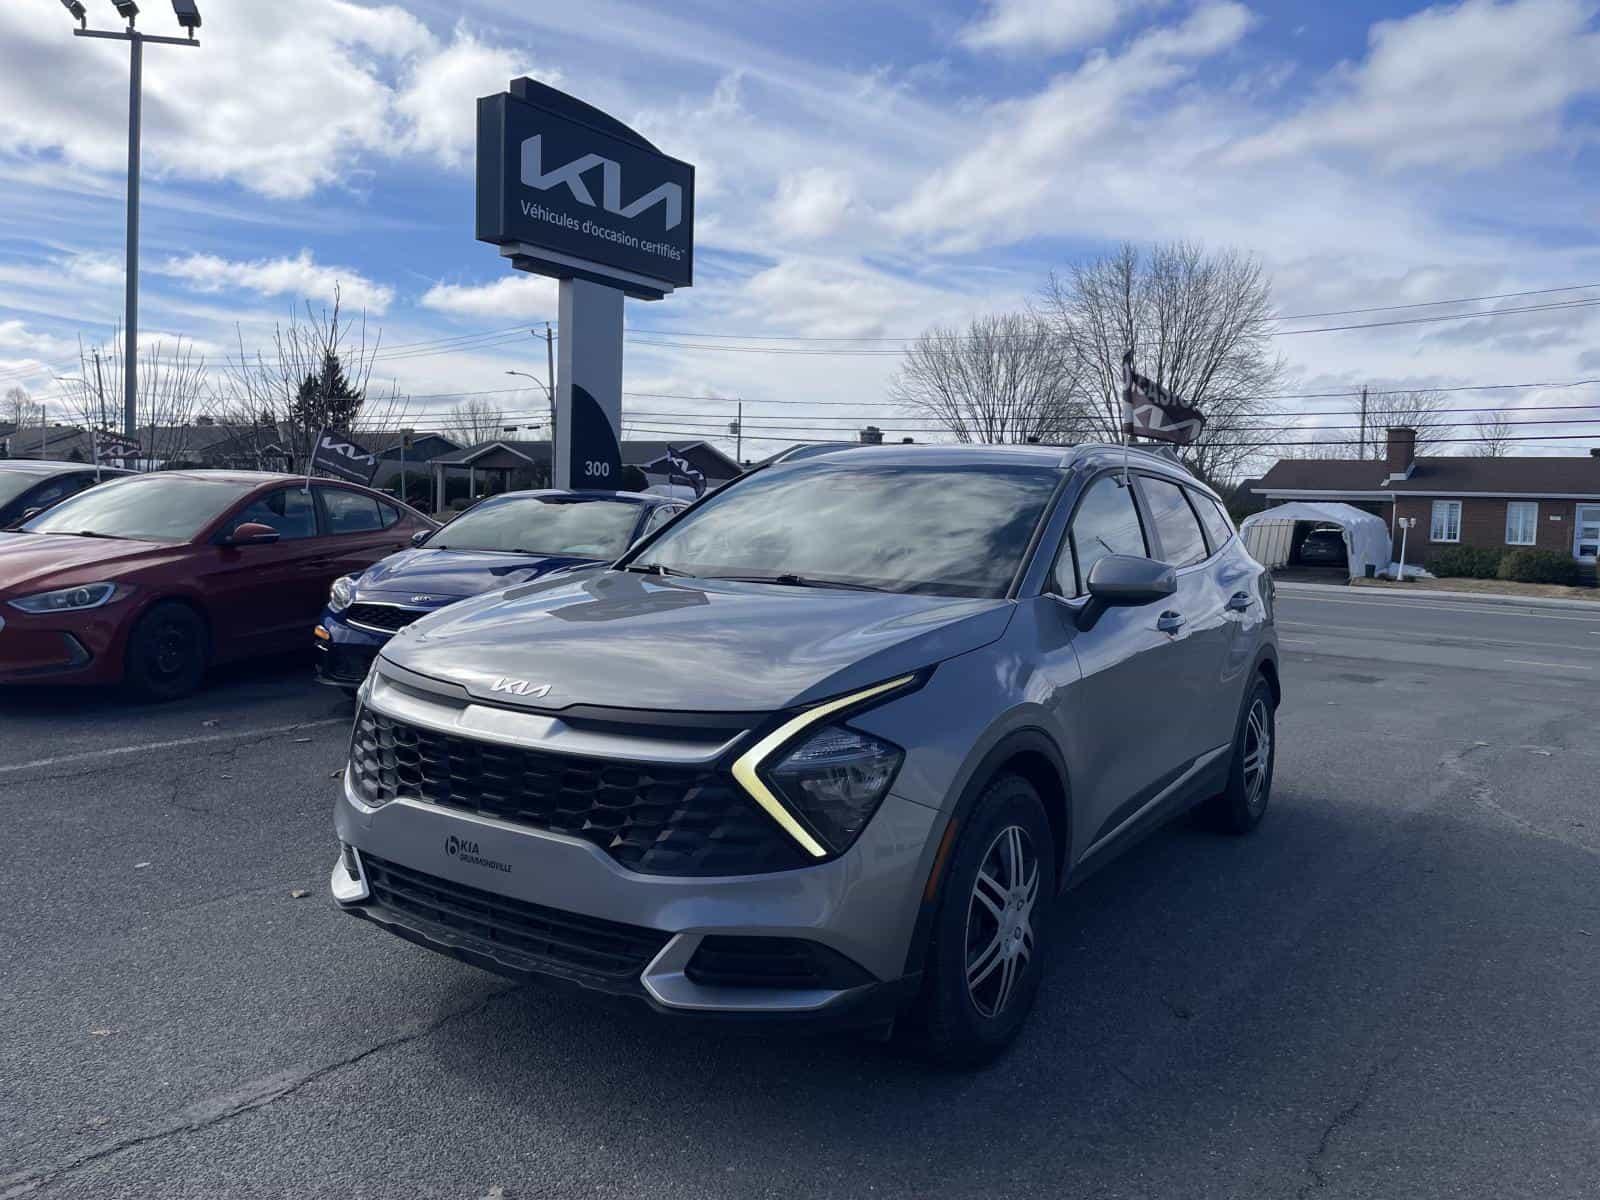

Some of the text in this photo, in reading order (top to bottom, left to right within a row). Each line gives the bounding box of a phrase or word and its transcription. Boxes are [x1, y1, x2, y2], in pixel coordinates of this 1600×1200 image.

[521, 135, 682, 232] KIA
[520, 199, 681, 261] Véhicules d'occasion certifiés
[585, 461, 610, 477] 300
[490, 678, 553, 699] KIA
[460, 839, 480, 854] KIA
